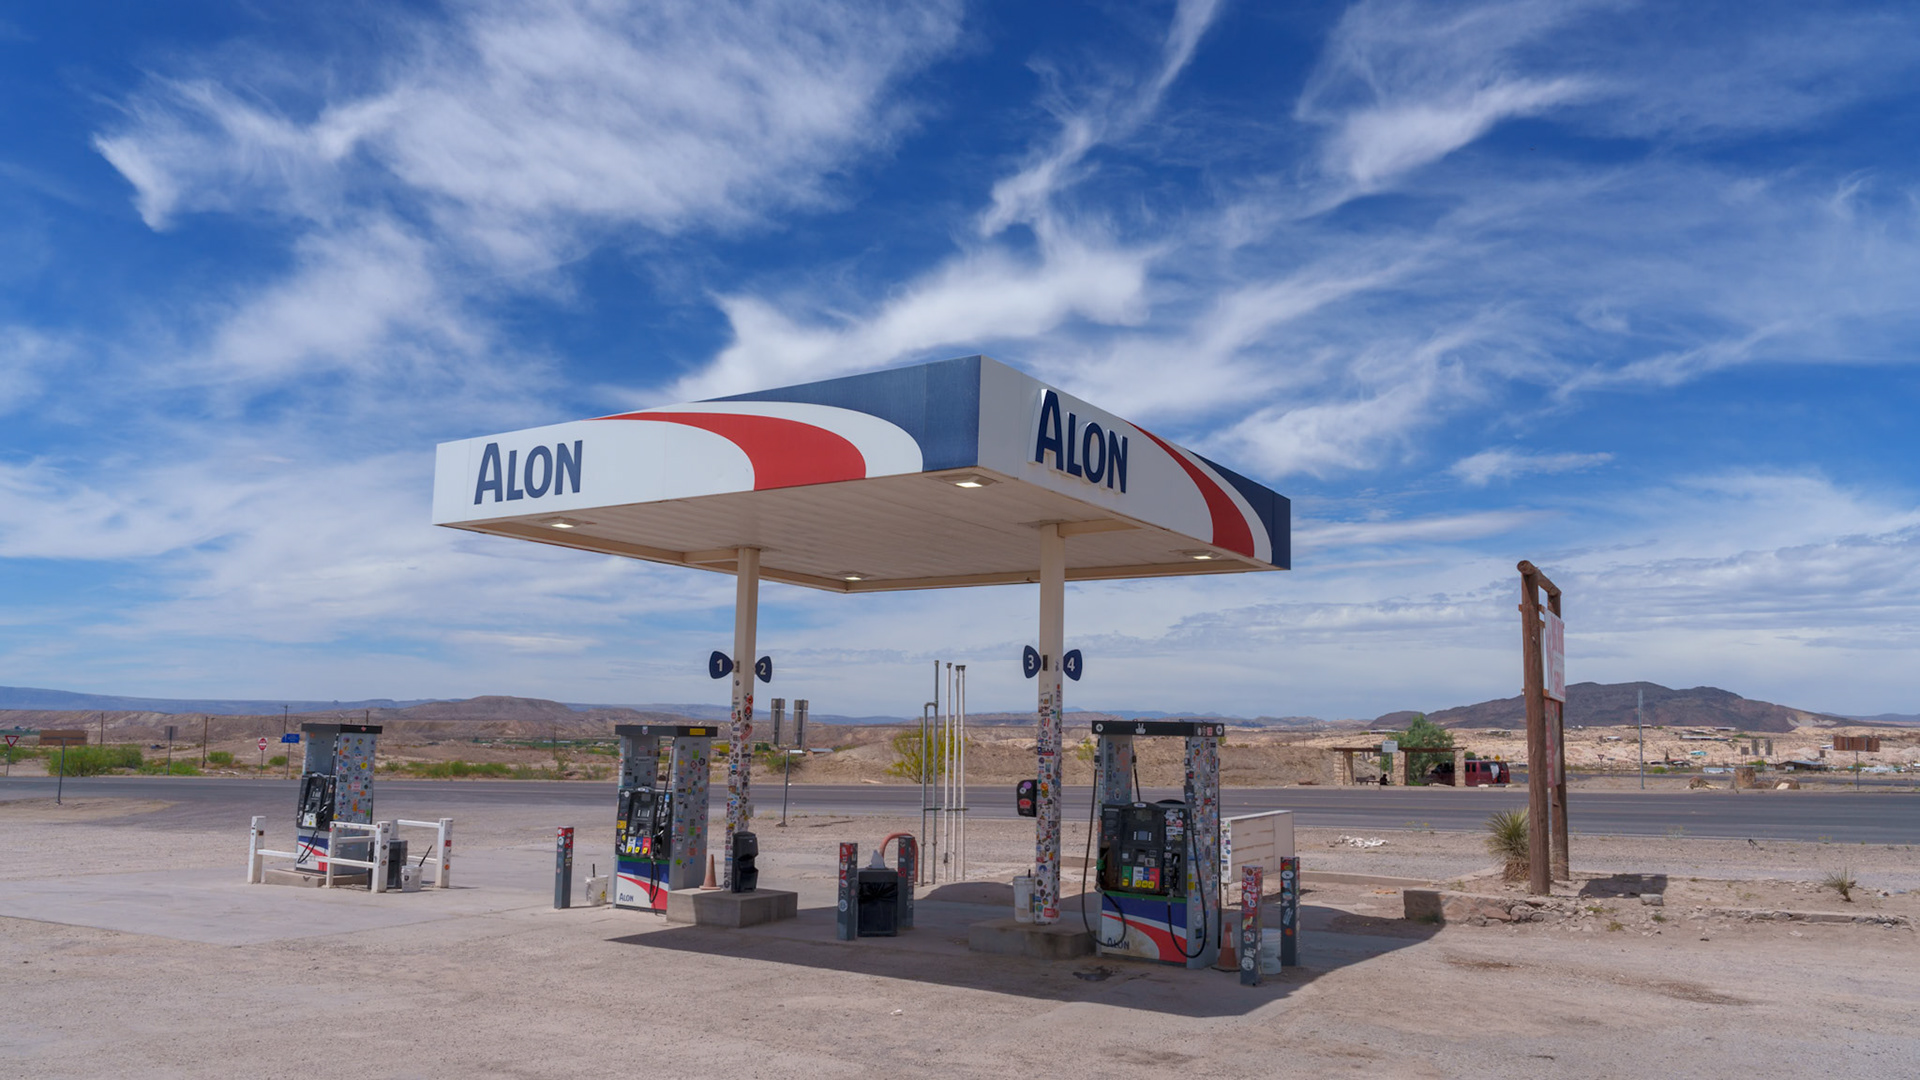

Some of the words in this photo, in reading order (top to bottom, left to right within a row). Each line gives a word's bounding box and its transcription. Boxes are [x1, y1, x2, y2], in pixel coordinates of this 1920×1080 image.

[1035, 389, 1128, 494] ALON
[474, 440, 583, 505] ALON
[716, 659, 724, 672] 1
[760, 662, 767, 676] 2
[1028, 654, 1035, 670] 3
[1067, 657, 1076, 672] 4
[619, 892, 634, 902] ALON
